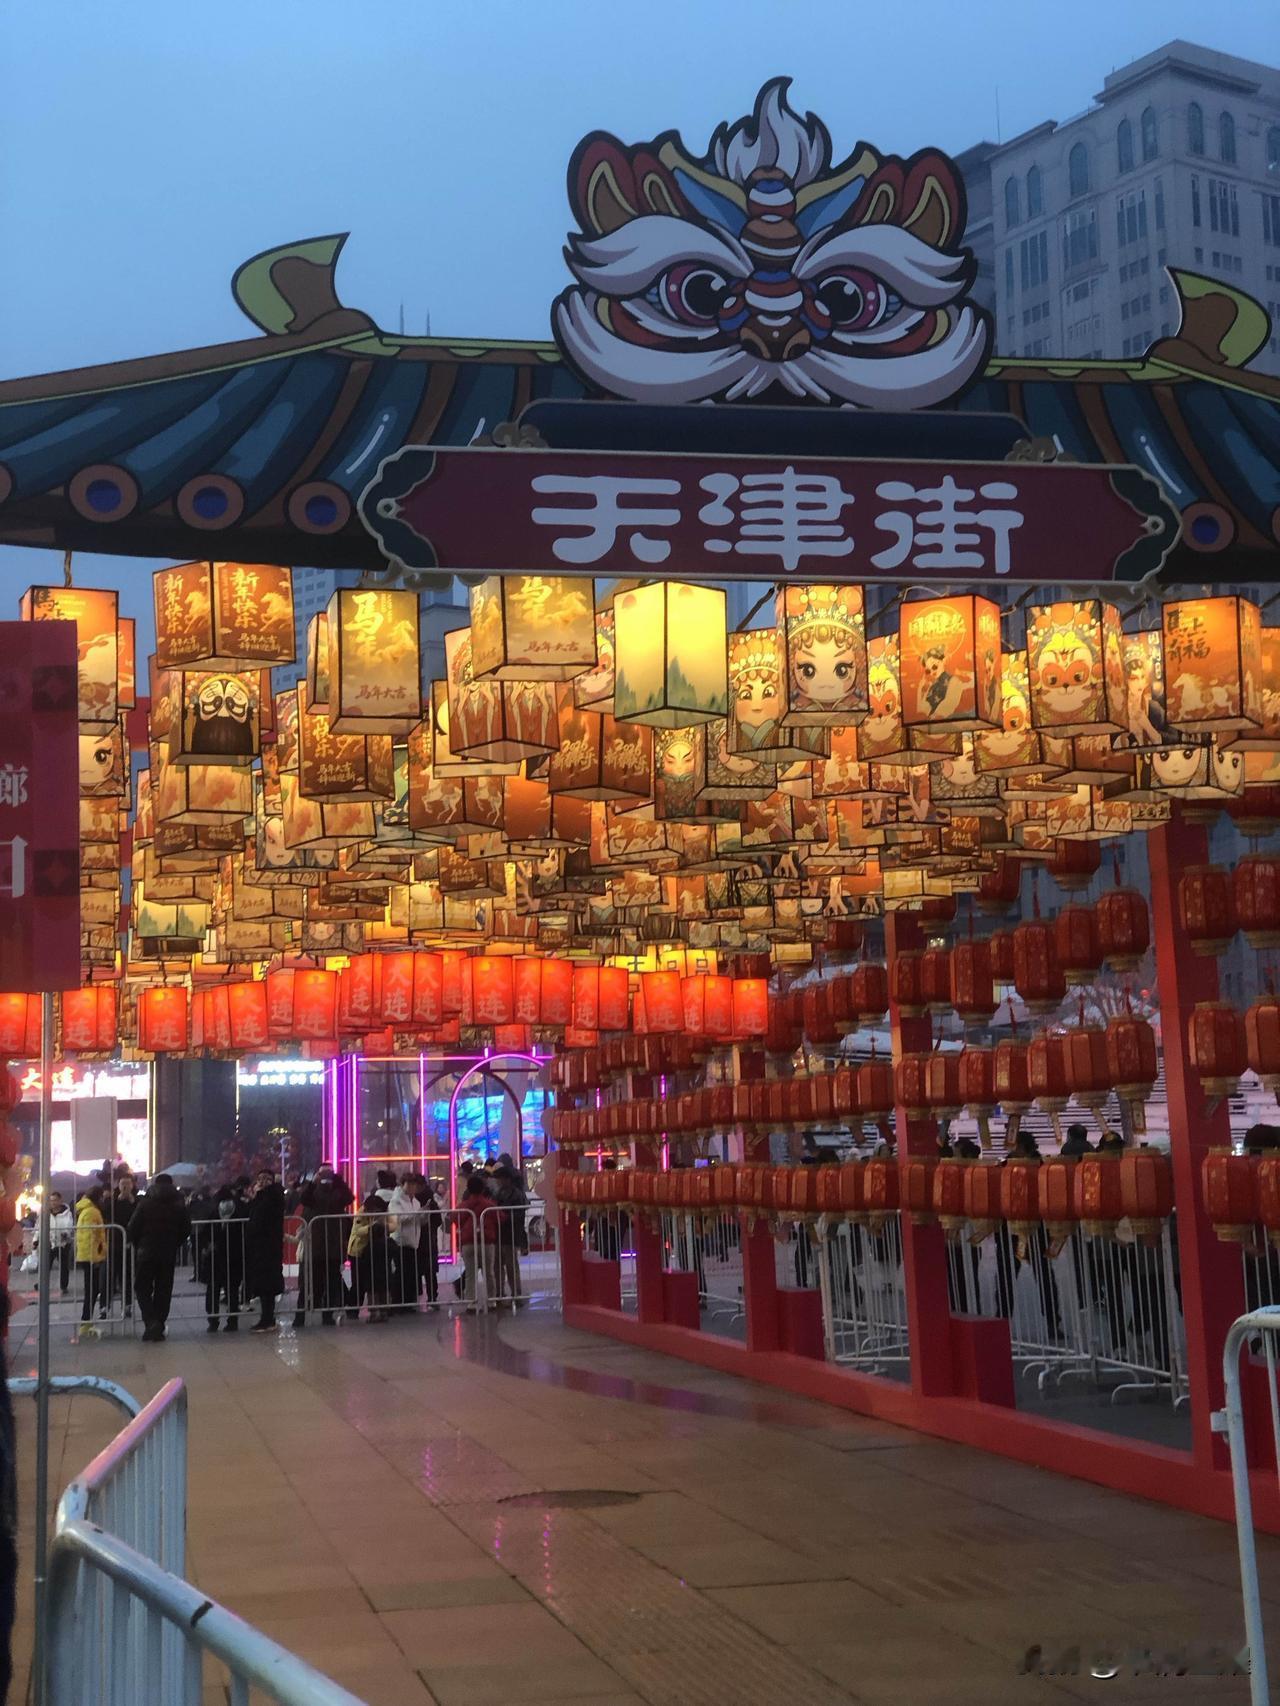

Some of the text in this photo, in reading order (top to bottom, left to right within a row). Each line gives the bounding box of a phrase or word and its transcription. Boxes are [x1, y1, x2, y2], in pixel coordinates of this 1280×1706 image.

[530, 465, 1025, 574] 天津街
[164, 573, 184, 634] 新年快乐
[230, 567, 260, 629] 新年快乐
[239, 632, 278, 643] 马年大吉
[523, 640, 580, 654] 马年大吉
[355, 684, 407, 700] 马年大吉
[614, 738, 643, 756] 2026
[352, 960, 372, 1012] 大连
[385, 959, 411, 1020] 大连
[415, 963, 440, 1021] 大连
[477, 964, 508, 1021] 大连
[518, 966, 539, 1021] 大连
